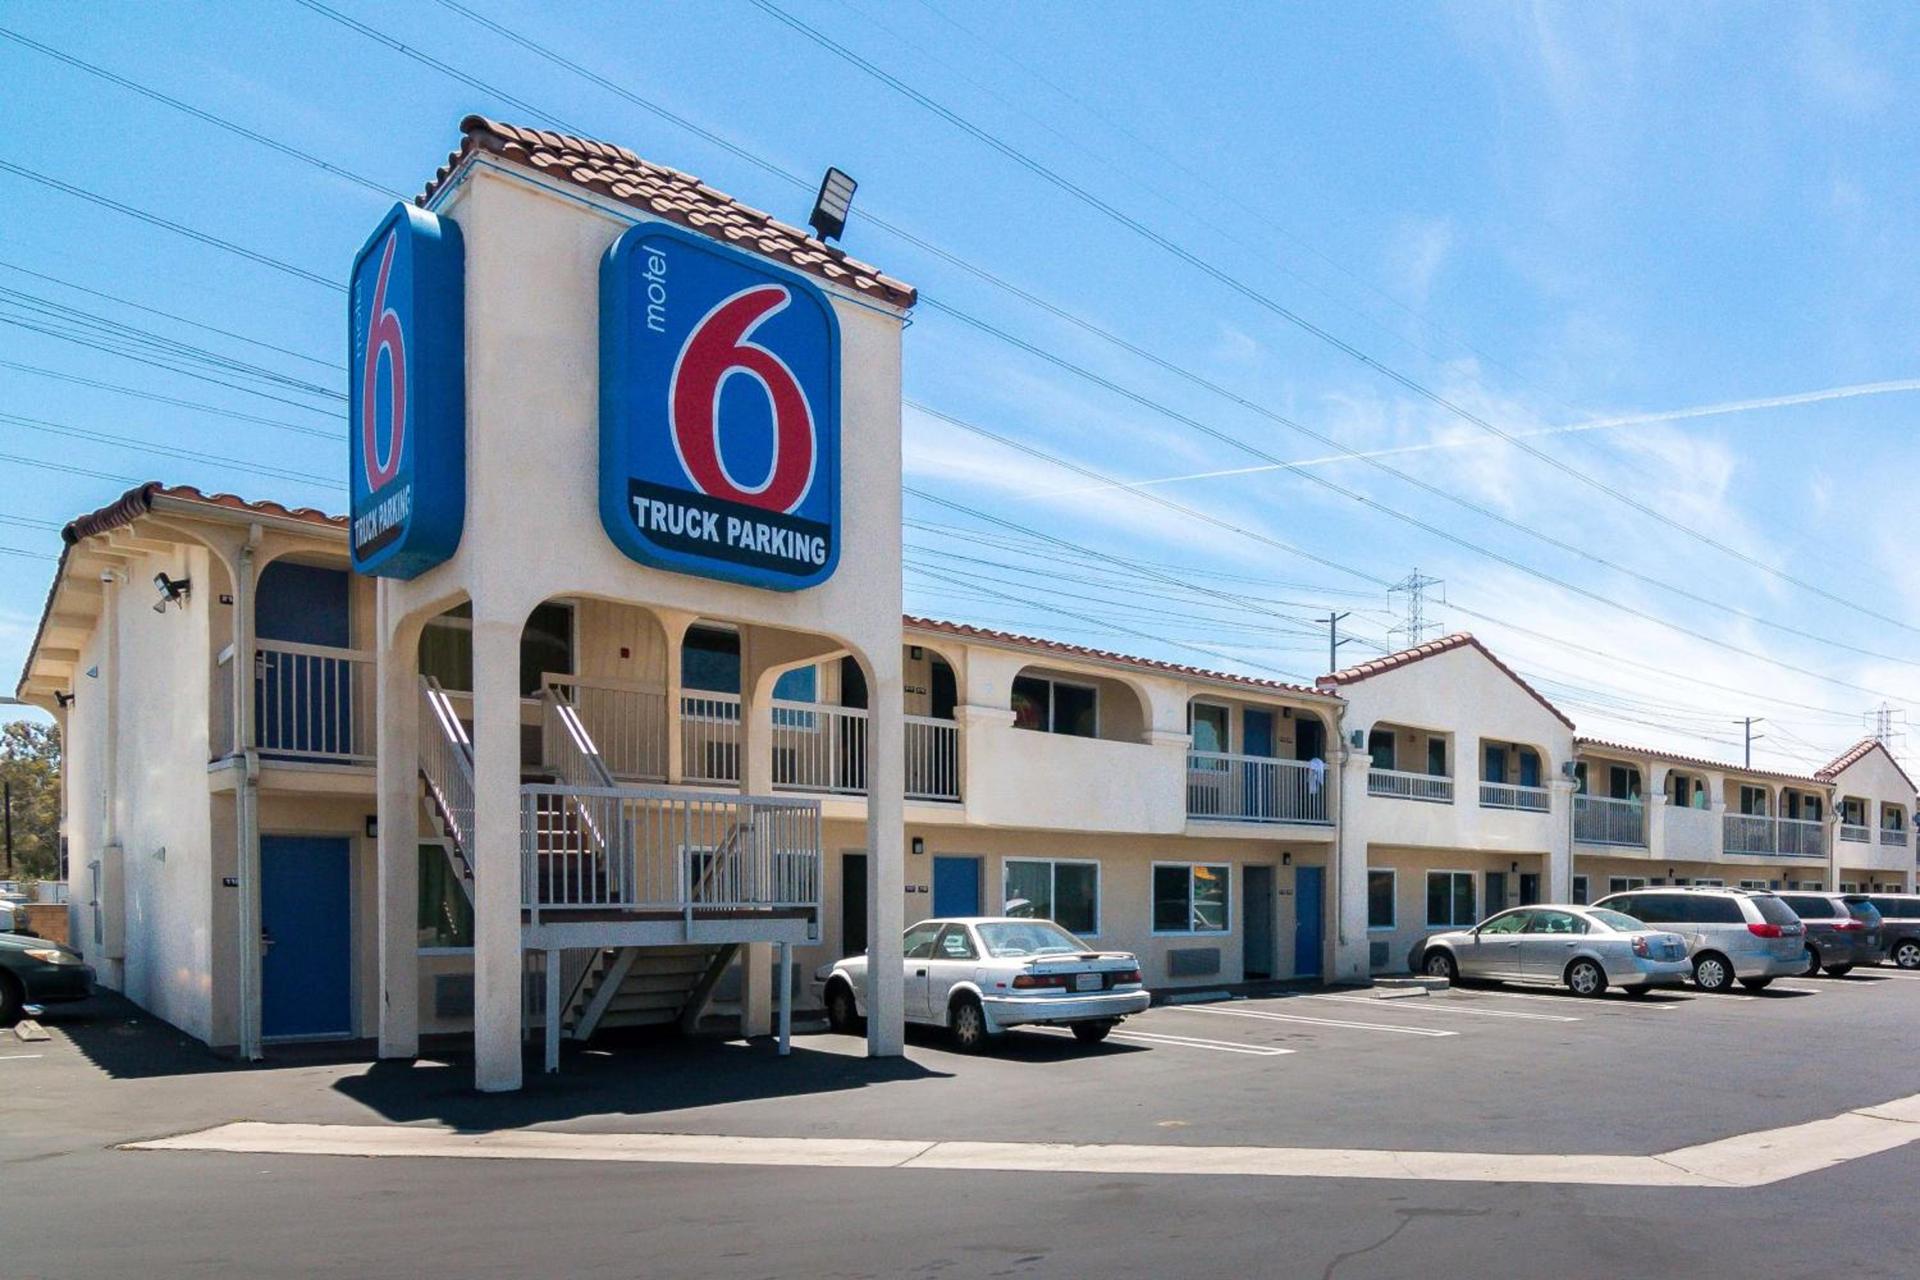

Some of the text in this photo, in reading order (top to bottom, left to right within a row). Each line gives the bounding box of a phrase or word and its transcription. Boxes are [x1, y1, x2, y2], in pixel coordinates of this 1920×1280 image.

[643, 246, 667, 333] motel
[363, 228, 407, 493] 6
[668, 283, 817, 514] 6
[355, 484, 411, 549] TRUCK PARKING
[633, 496, 826, 566] TRUCK PARKING
